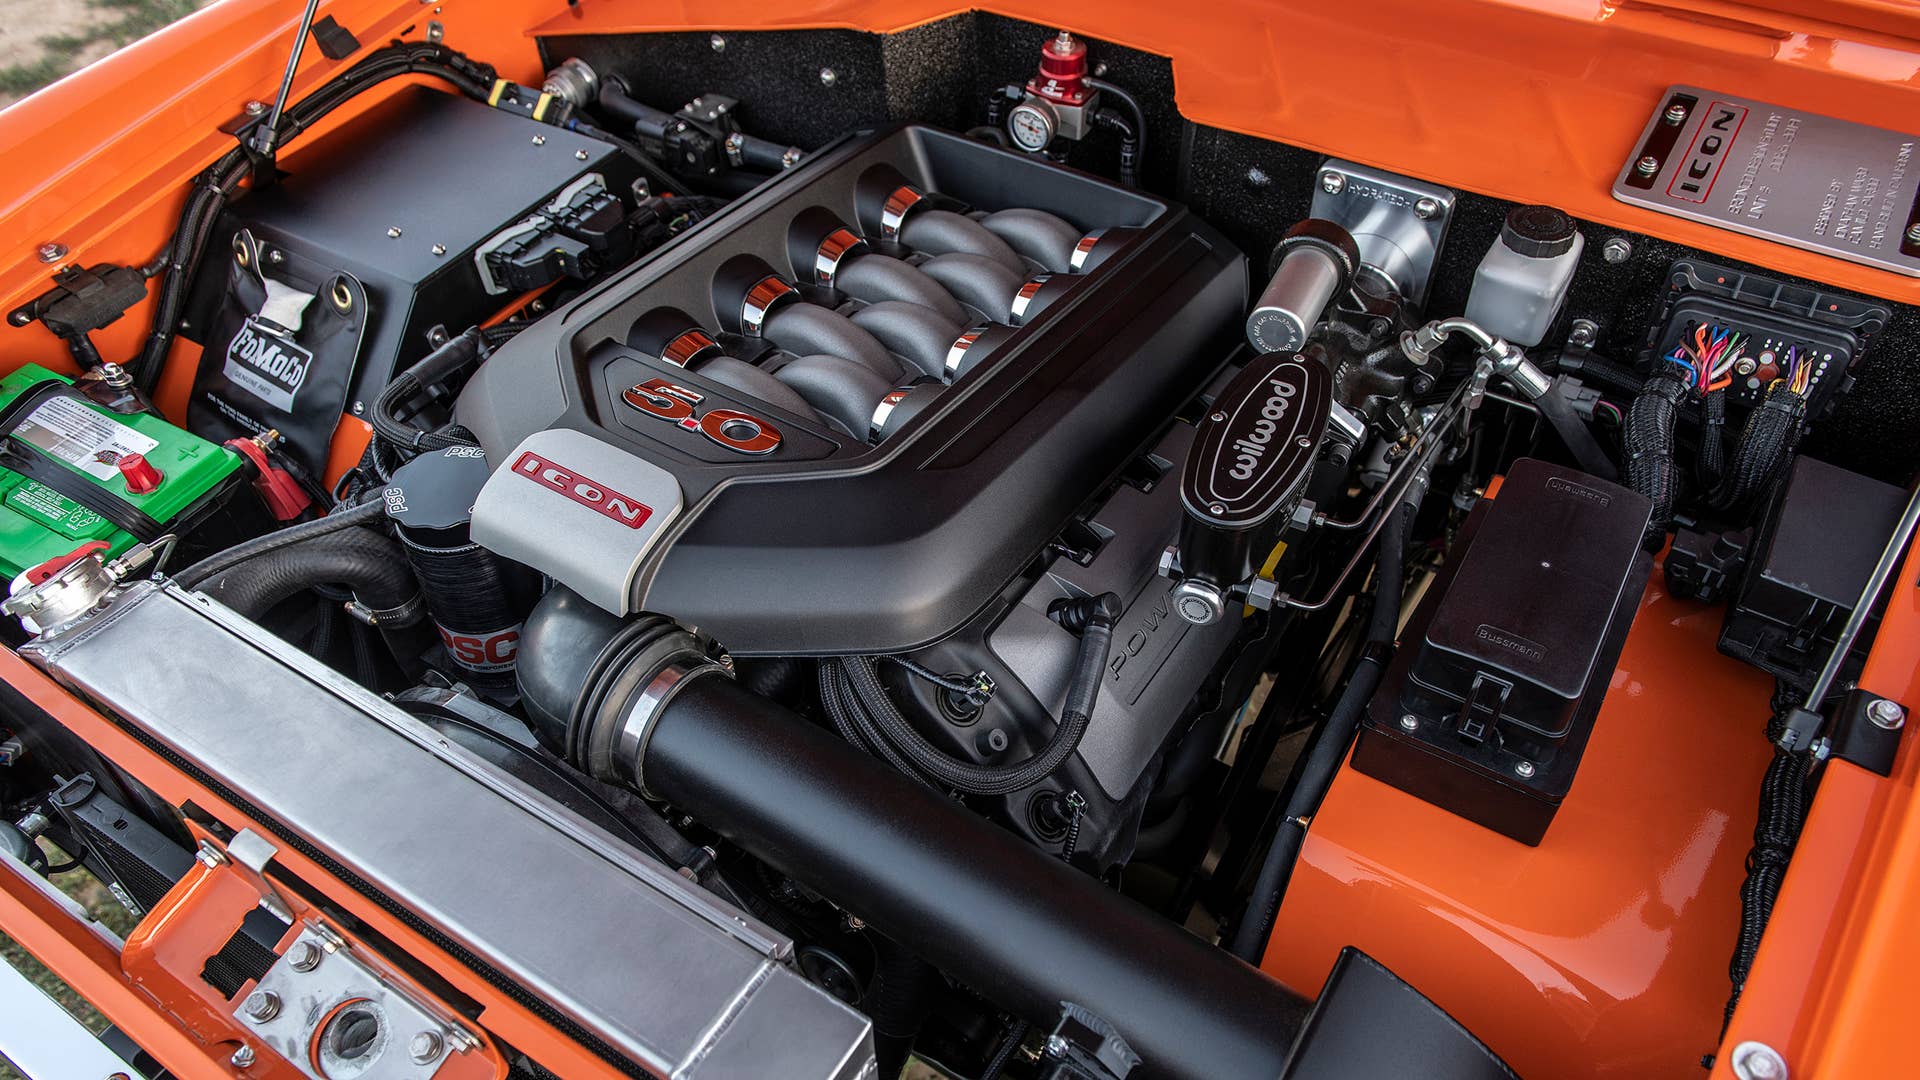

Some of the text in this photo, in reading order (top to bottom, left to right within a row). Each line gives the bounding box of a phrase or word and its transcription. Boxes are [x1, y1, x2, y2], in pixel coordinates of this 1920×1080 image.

[1680, 109, 1736, 193] ICON
[444, 446, 486, 459] PSC
[621, 377, 785, 457] 5.0
[1228, 378, 1297, 481] wilwood
[384, 487, 409, 514] PSC
[523, 458, 643, 522] ICON
[1109, 590, 1173, 682] POW
[1479, 628, 1542, 661] Bussmann
